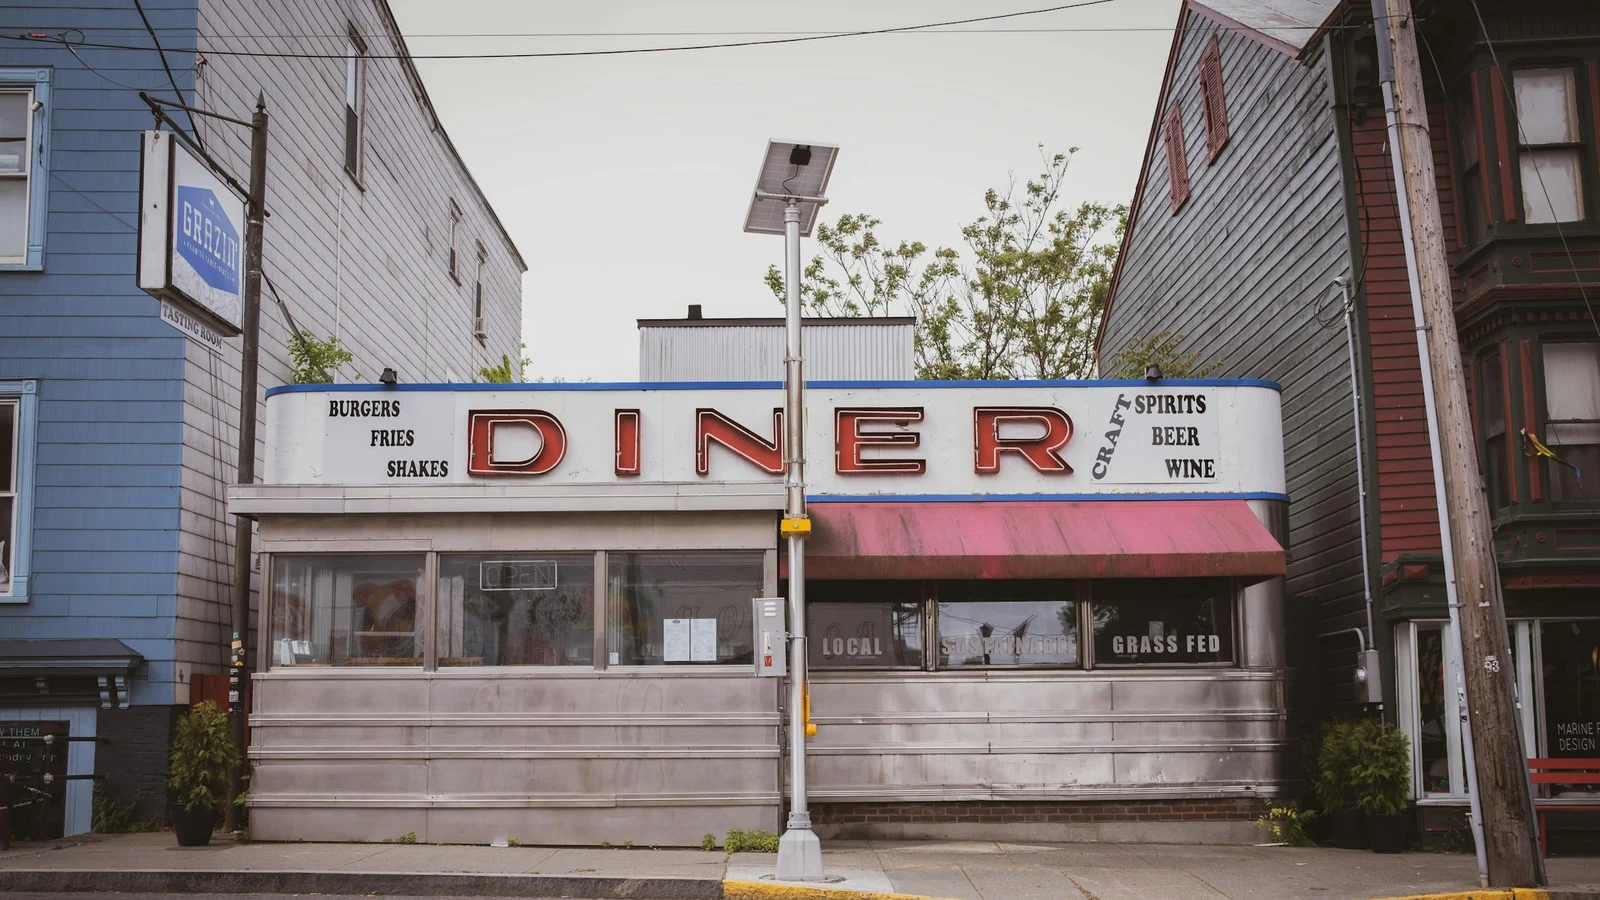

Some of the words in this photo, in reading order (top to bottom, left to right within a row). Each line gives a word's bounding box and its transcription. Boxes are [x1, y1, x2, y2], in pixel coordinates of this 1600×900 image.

[183, 200, 238, 272] GRAZIN'
[162, 303, 199, 335] TASTING
[200, 325, 223, 349] ROOM
[328, 400, 400, 418] BURGERS
[1134, 394, 1207, 414] SPIRITS
[370, 429, 415, 447] FRIES
[467, 406, 1075, 477] DINER
[1092, 393, 1132, 480] CRAFT
[1151, 426, 1200, 446] BEER
[387, 460, 449, 478] SHAKES
[1164, 458, 1216, 478] WINE
[485, 564, 550, 588] OPEN
[822, 637, 882, 655] LOCAL
[941, 636, 1076, 655] SUSTAINABLE
[1112, 635, 1178, 653] GRASS
[1186, 634, 1220, 653] FED
[1484, 660, 1500, 673] 93
[9, 727, 40, 736] THEM
[1557, 721, 1594, 735] MARINE
[1559, 737, 1596, 751] DESIGN
